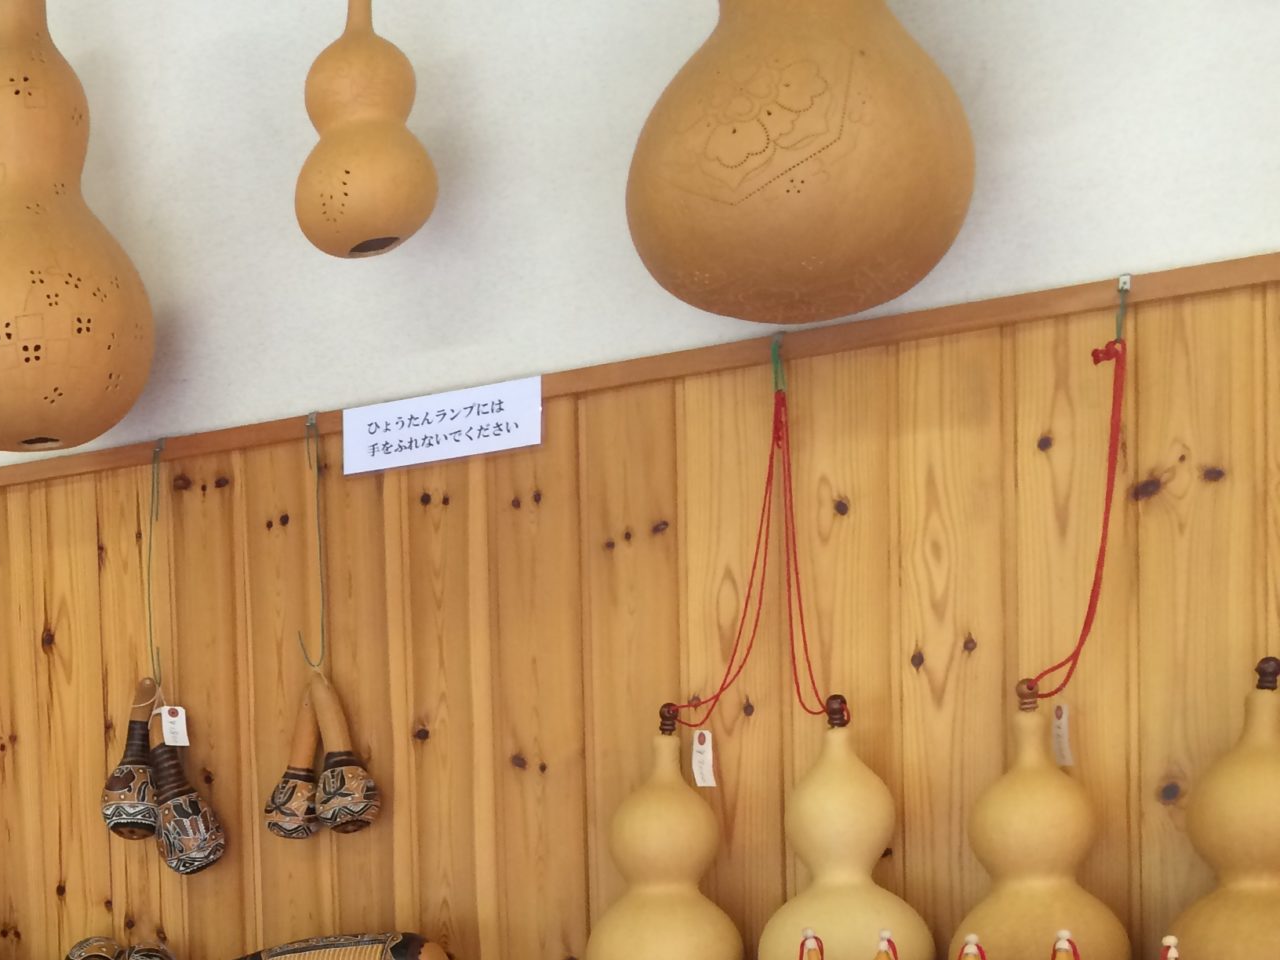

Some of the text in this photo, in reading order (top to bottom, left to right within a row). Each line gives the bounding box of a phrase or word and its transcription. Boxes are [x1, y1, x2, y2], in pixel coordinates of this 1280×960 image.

[367, 399, 505, 435] ひょうたんランプには
[367, 423, 520, 458] 手をふれないでください
